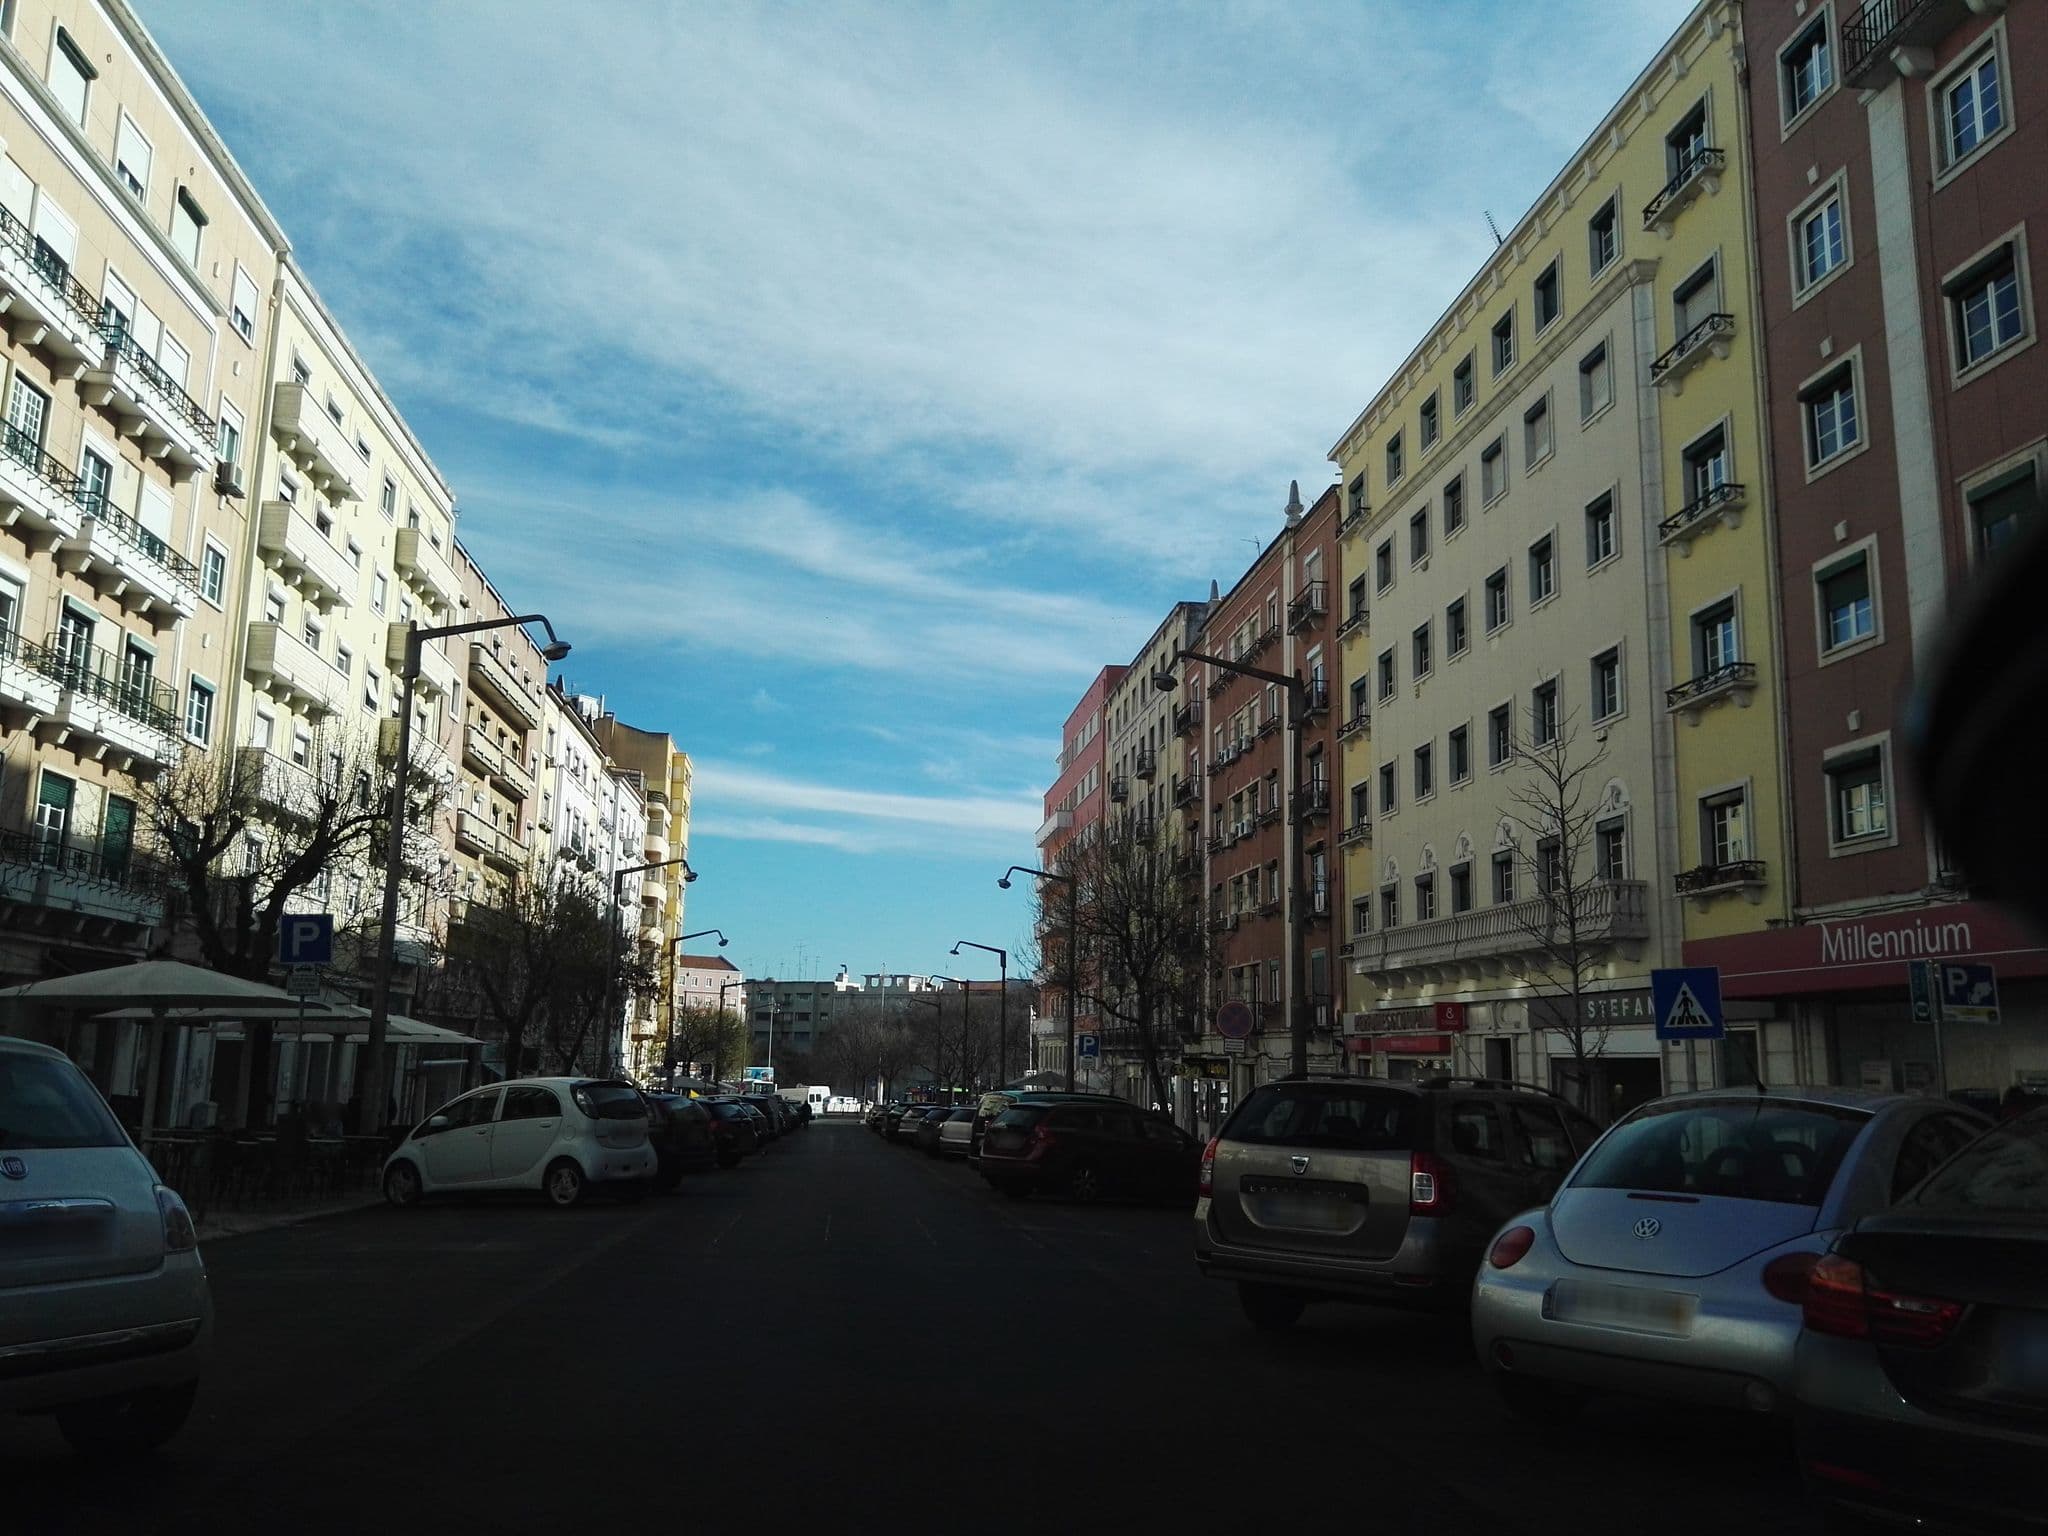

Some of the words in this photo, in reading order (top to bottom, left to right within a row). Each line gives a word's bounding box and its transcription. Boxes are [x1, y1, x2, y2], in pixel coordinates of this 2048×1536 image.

[291, 921, 321, 957] P
[1820, 917, 1972, 963] Millennium
[1946, 967, 1968, 996] P
[1082, 1036, 1096, 1052] P
